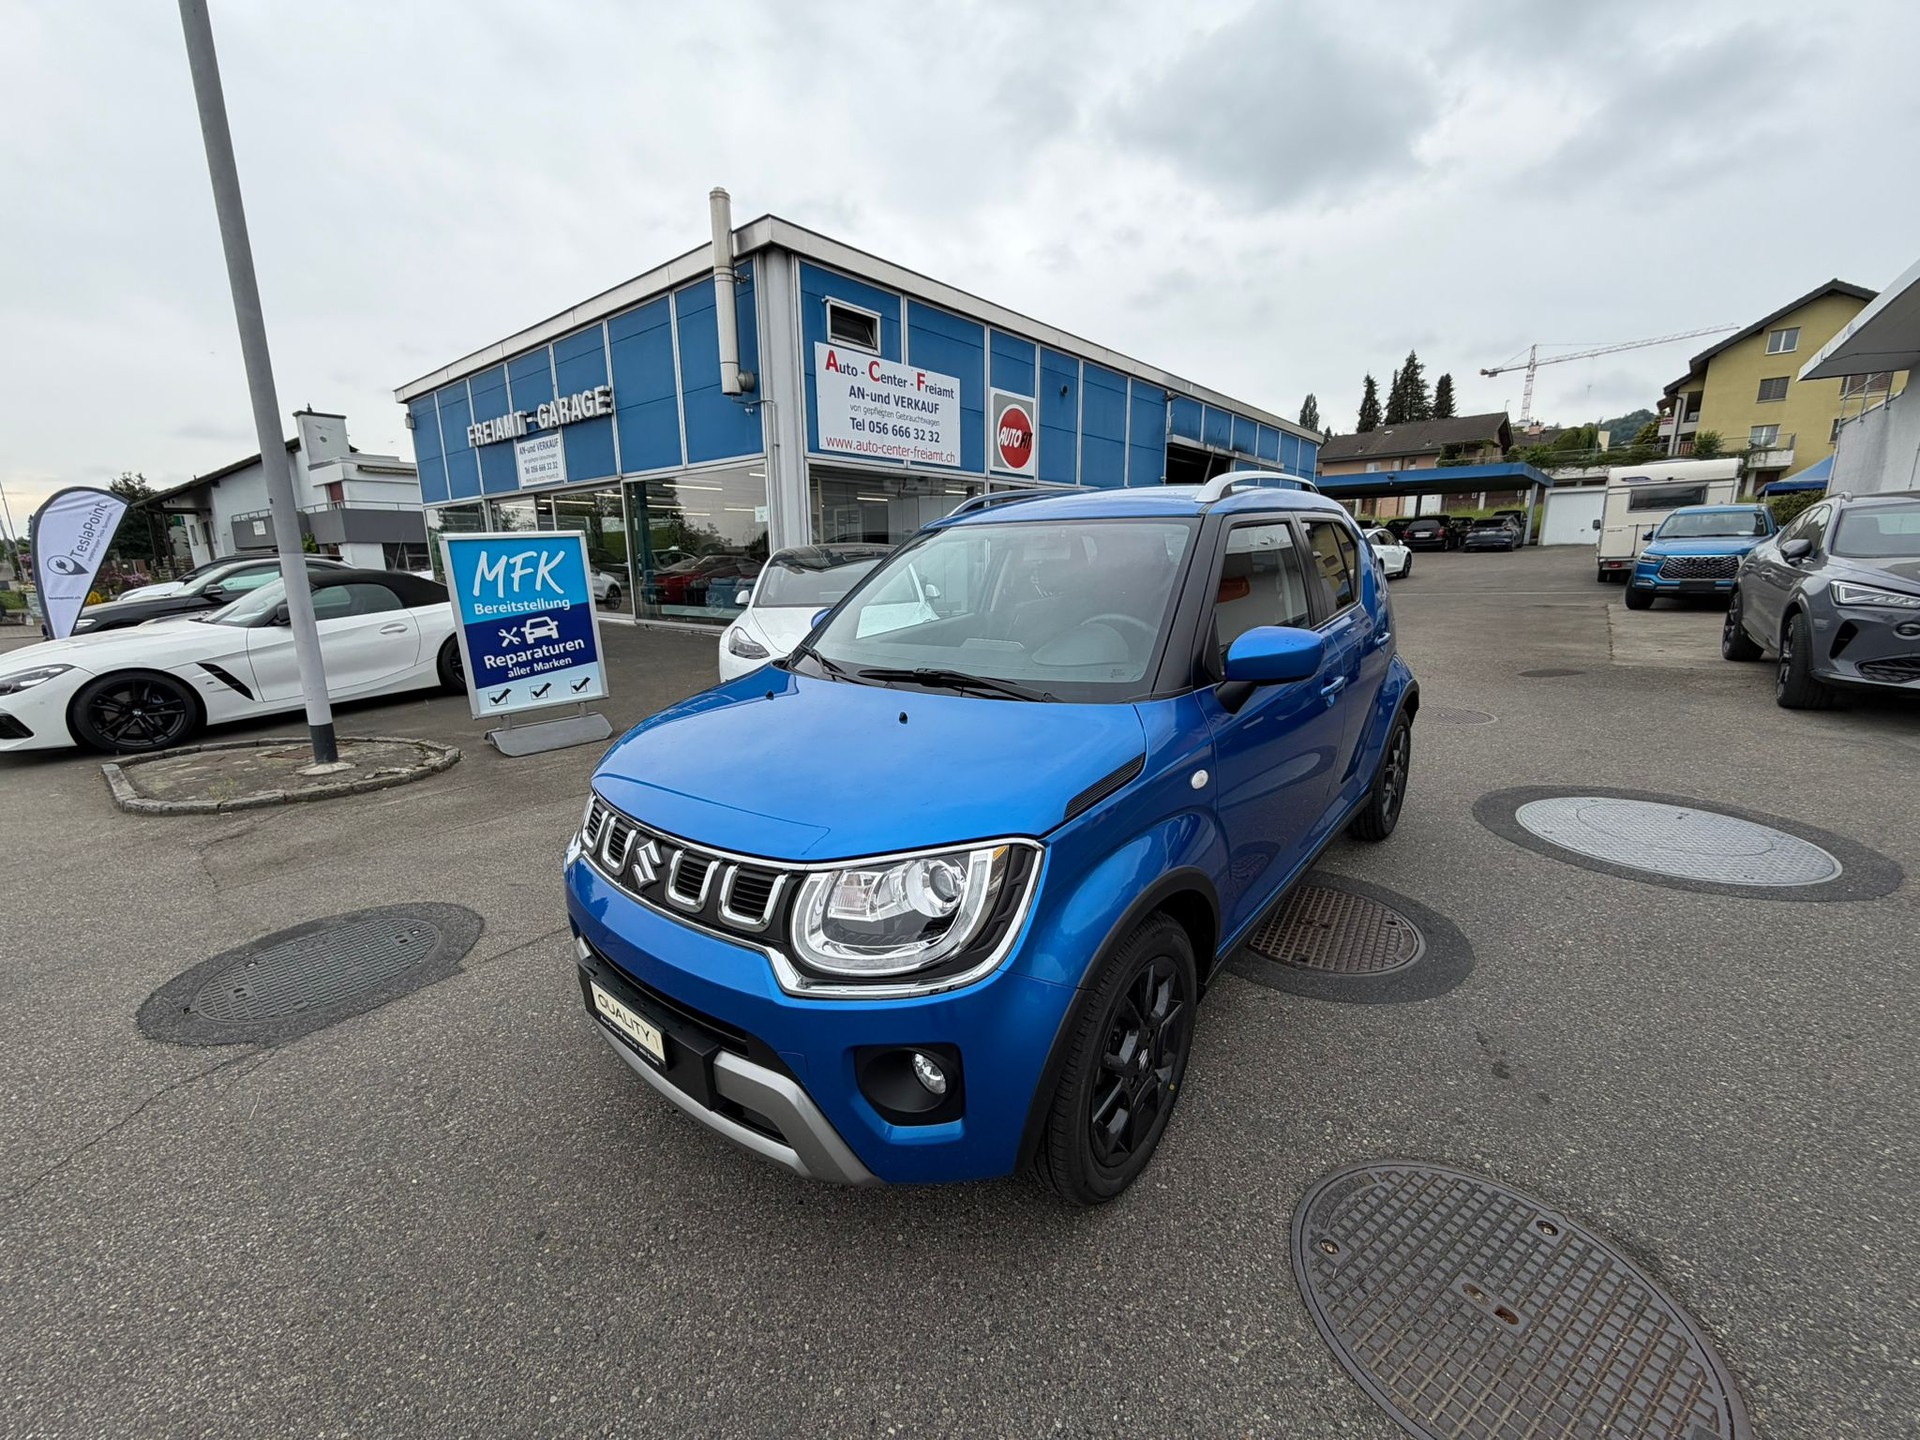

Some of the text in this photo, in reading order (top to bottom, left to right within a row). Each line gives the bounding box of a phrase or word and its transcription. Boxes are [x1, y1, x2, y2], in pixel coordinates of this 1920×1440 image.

[825, 350, 858, 377] Auto
[868, 361, 908, 388] Center
[916, 372, 955, 400] Freiamt
[849, 385, 940, 414] AN-und VERKAUF
[849, 404, 862, 413] von
[849, 416, 940, 443] Tel 056 666 32 32
[826, 436, 956, 464] www.auto-center-freiamt.ch
[69, 502, 108, 558] TeslaPoint
[472, 550, 565, 598] MFK
[473, 598, 571, 615] Bereitstellung
[483, 638, 585, 670] Reparaturen
[507, 656, 572, 679] aller Marken
[598, 993, 650, 1042] QUALITY
